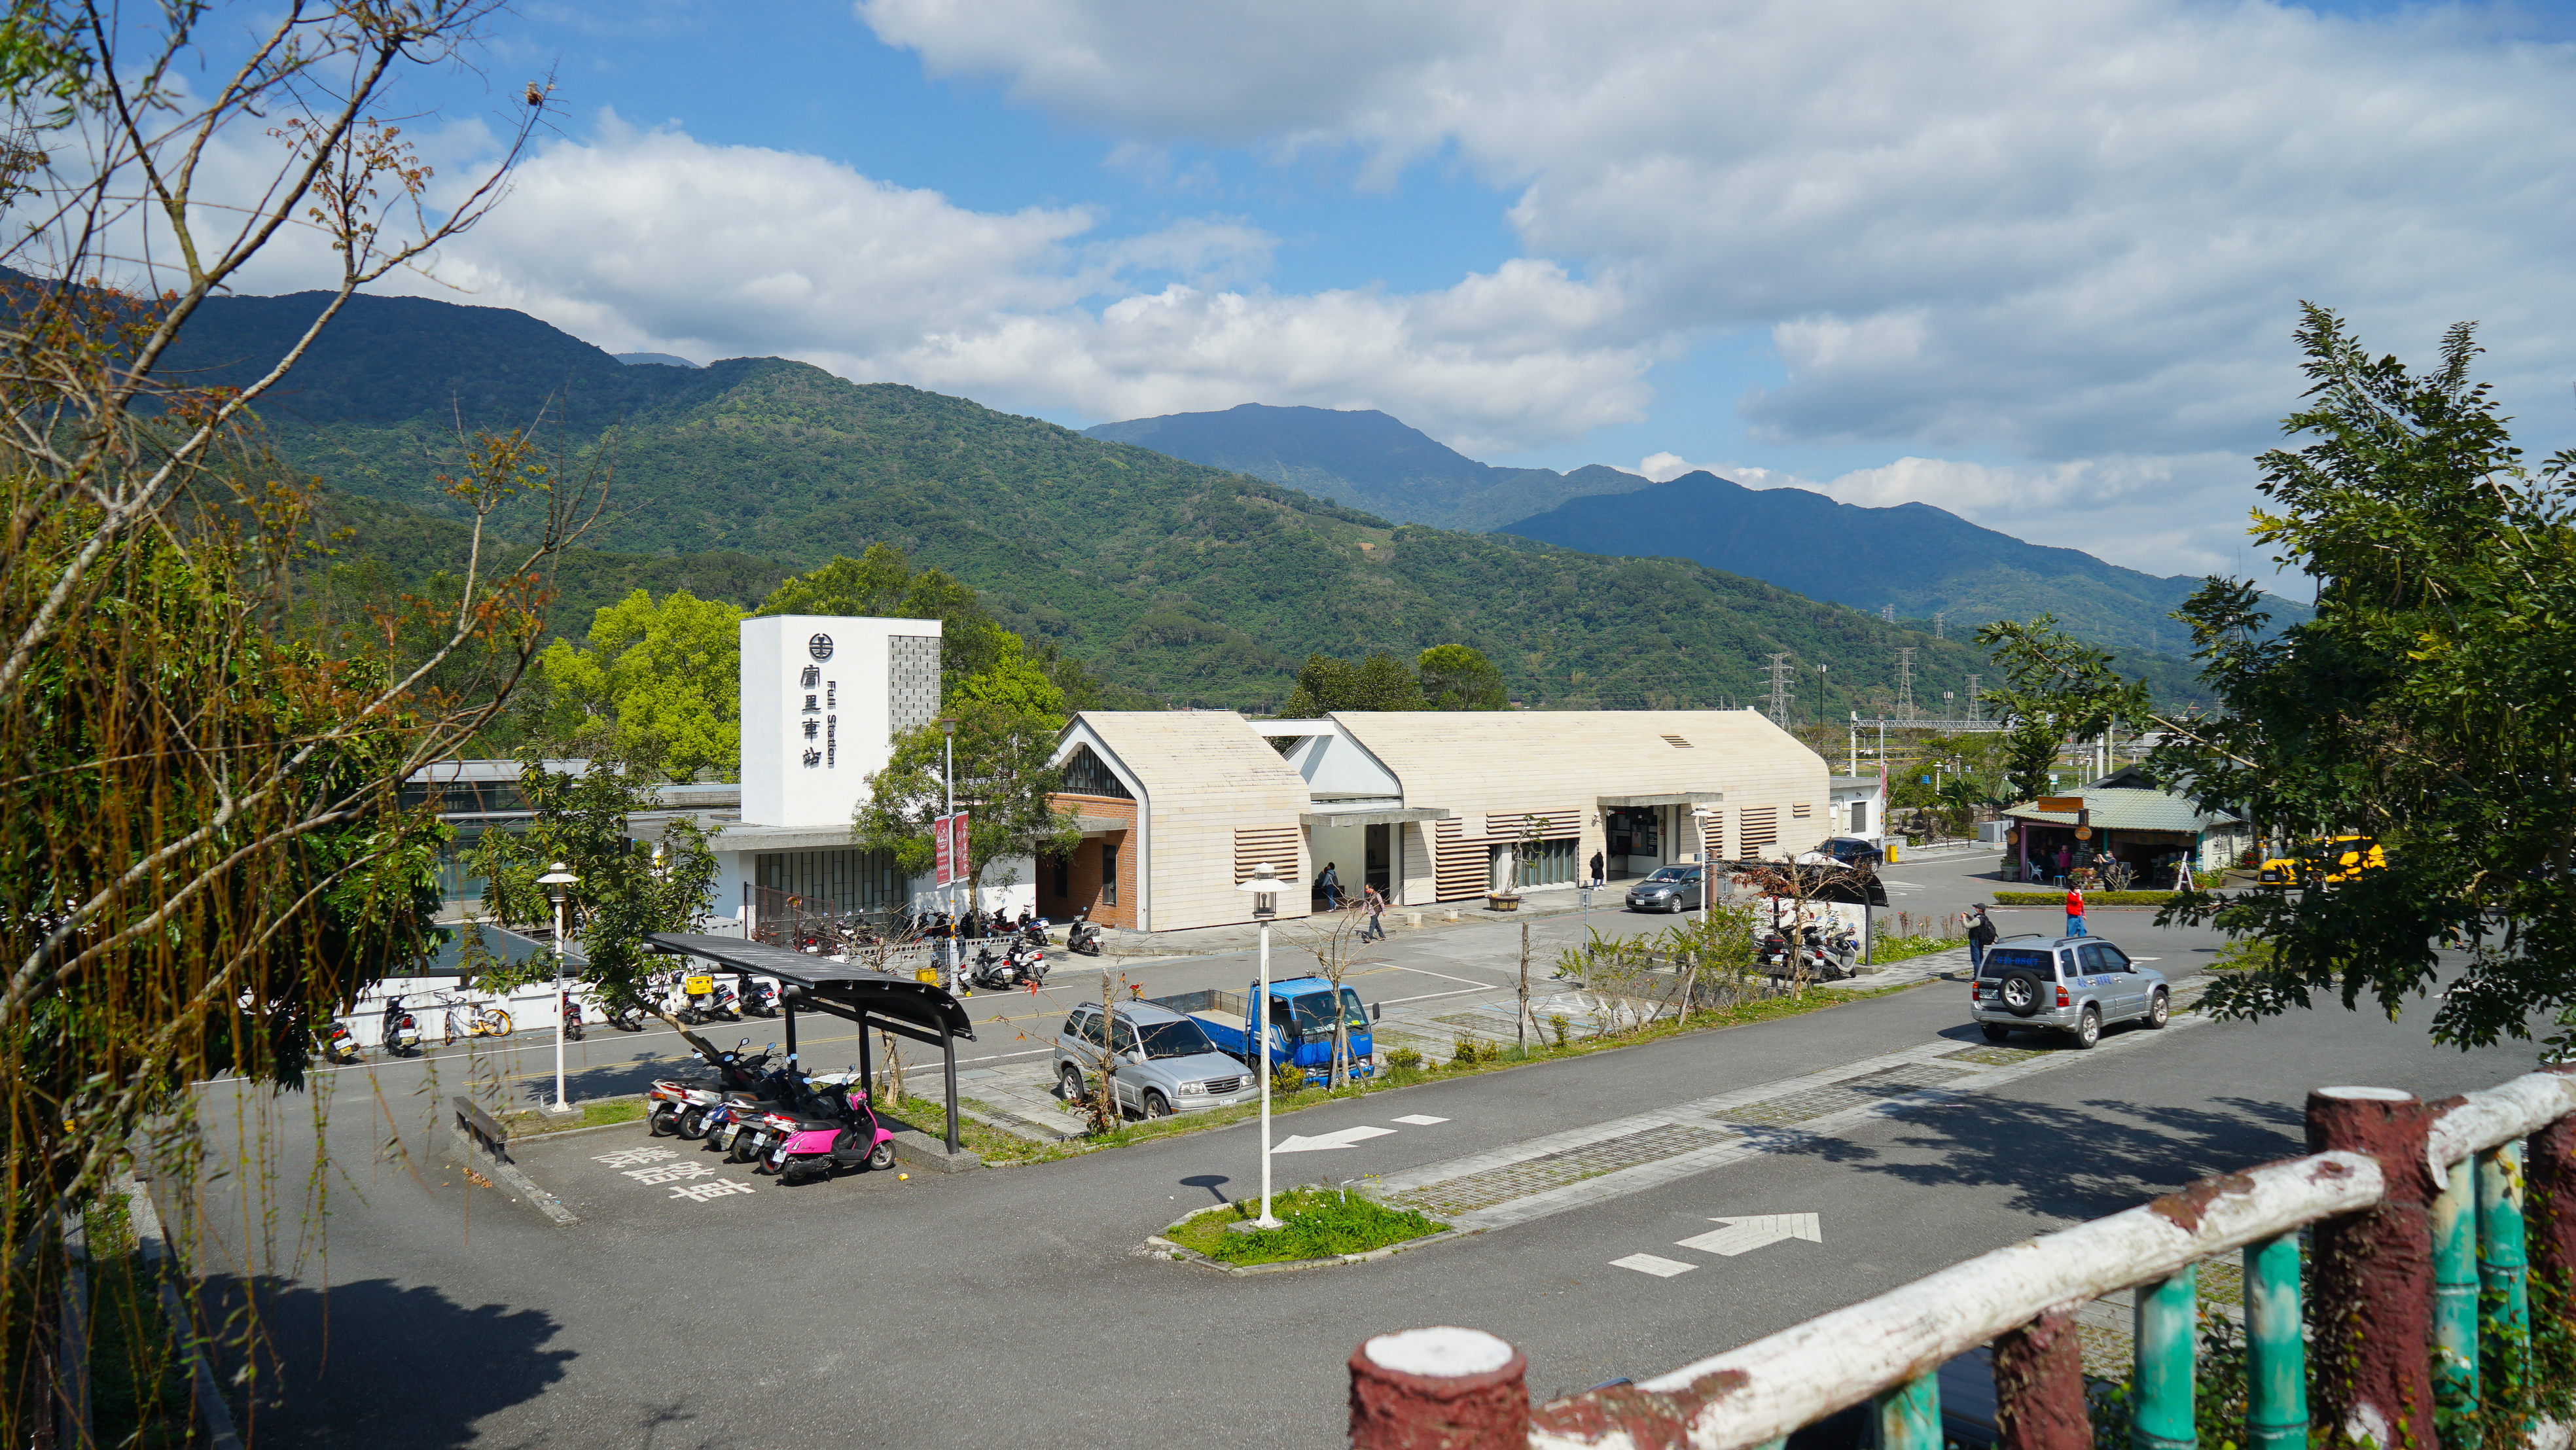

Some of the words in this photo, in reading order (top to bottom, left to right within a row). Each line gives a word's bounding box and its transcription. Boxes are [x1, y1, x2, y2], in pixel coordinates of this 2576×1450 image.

[800, 665, 822, 767] 富里車站
[827, 681, 836, 707] Fuli
[827, 715, 836, 767] Station
[1997, 956, 2039, 966] 6D-0807
[590, 1145, 757, 1203] 機踏車
